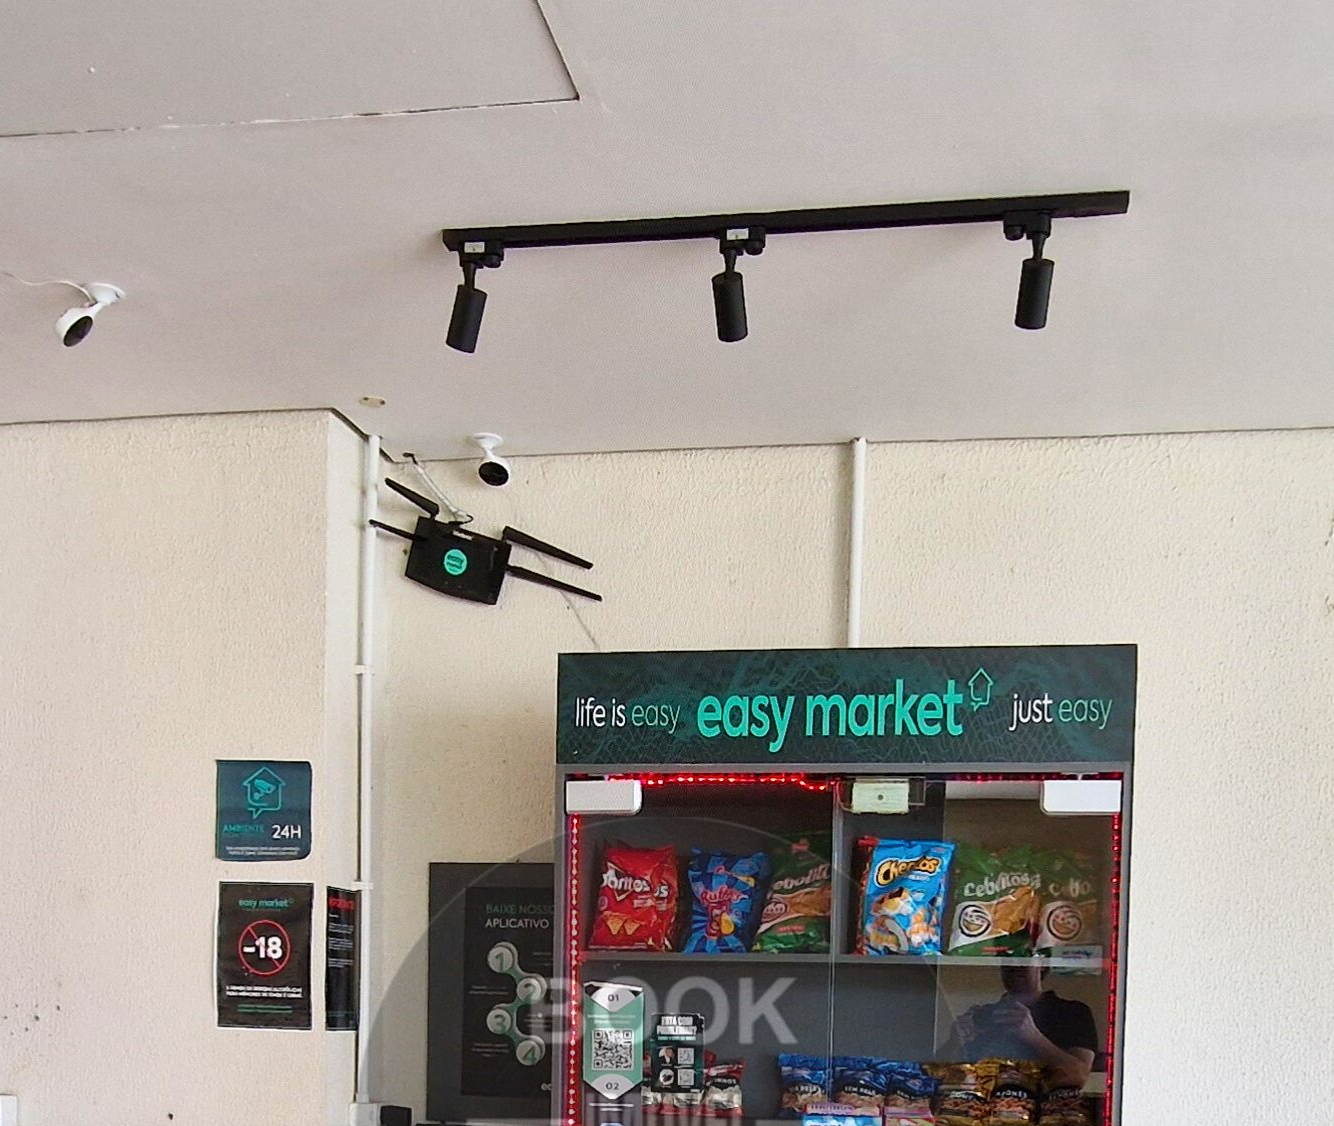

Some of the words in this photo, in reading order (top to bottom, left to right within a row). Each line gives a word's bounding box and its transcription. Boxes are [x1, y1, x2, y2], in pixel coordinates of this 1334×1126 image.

[575, 697, 606, 727] life
[611, 698, 626, 727] is
[631, 704, 681, 734] easy
[697, 694, 795, 753] easy
[805, 678, 964, 737] market
[1008, 693, 1053, 731] just
[1058, 697, 1114, 730] easy
[271, 824, 302, 839] 24H
[239, 899, 258, 909] easy
[258, 898, 289, 908] market
[485, 904, 517, 915] BAIXE
[484, 918, 550, 929] APLICATIVO
[243, 936, 283, 959] -18
[607, 993, 620, 1002] 01
[605, 1081, 620, 1091] 02
